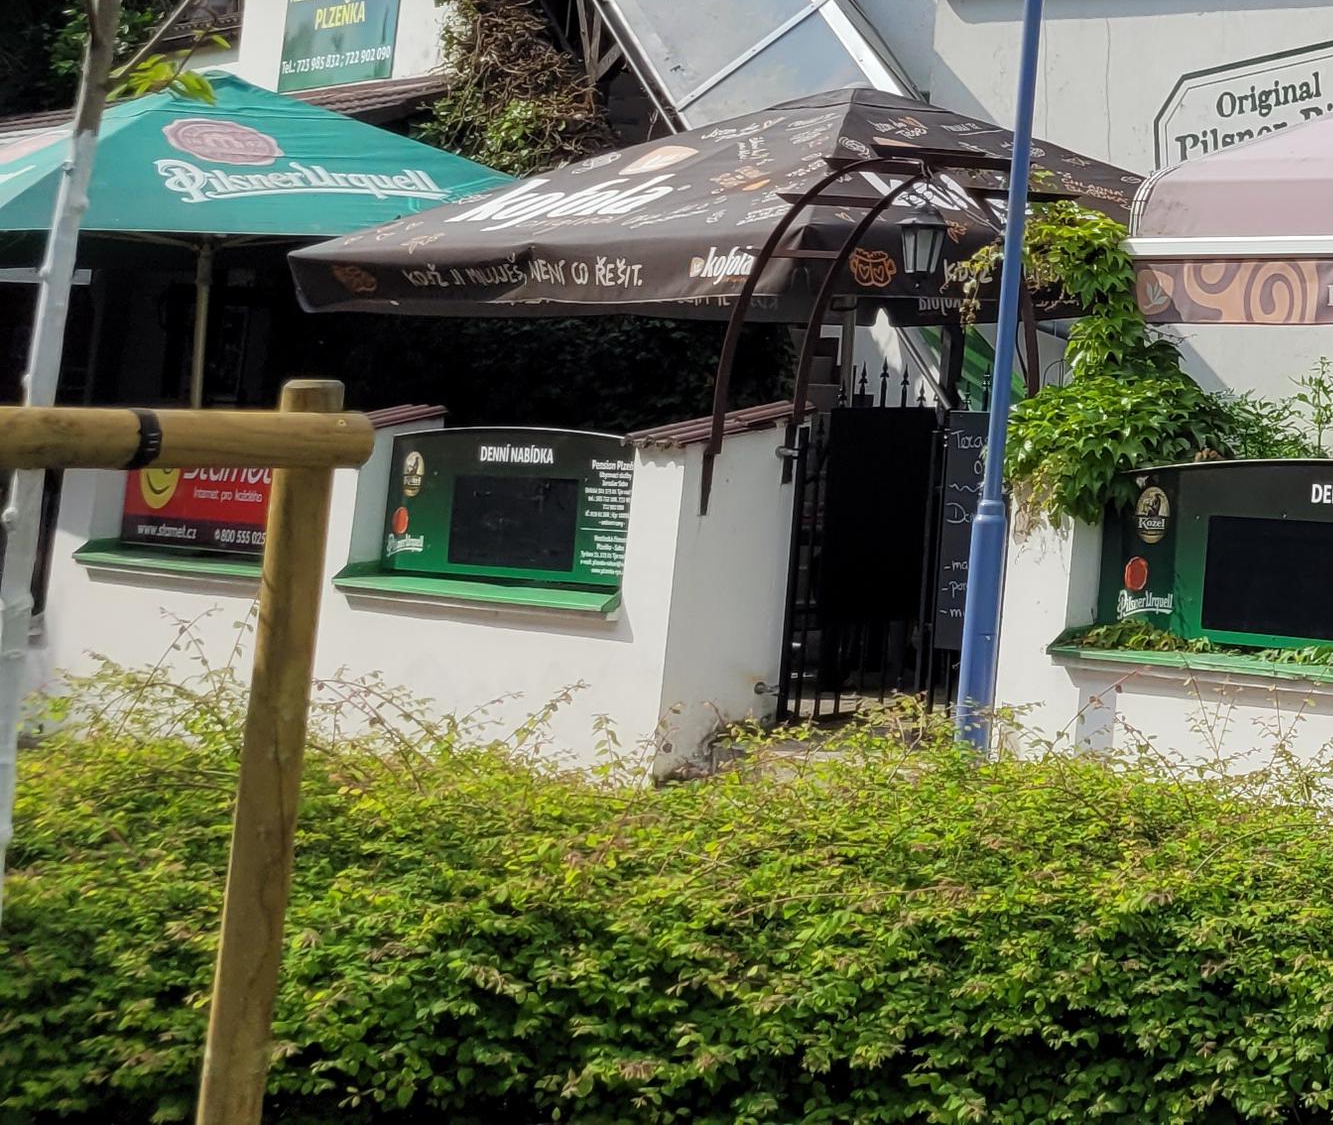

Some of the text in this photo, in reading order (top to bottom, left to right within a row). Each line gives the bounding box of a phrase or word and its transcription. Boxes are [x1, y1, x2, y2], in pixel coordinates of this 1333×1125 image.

[315, 0, 365, 30] PLZEŇKA
[1216, 71, 1322, 118] Original
[153, 159, 446, 203] Pilsner Urquell
[445, 174, 677, 232] kofola
[529, 259, 567, 286] NENÍ
[571, 261, 588, 286] CO
[700, 246, 756, 285] kofola
[480, 443, 554, 464] DENNÍ NABÍDKA
[220, 528, 235, 543] 800
[236, 530, 250, 544] 555
[1138, 517, 1165, 529] Kozel
[1117, 589, 1174, 620] Pilsner Urquell
